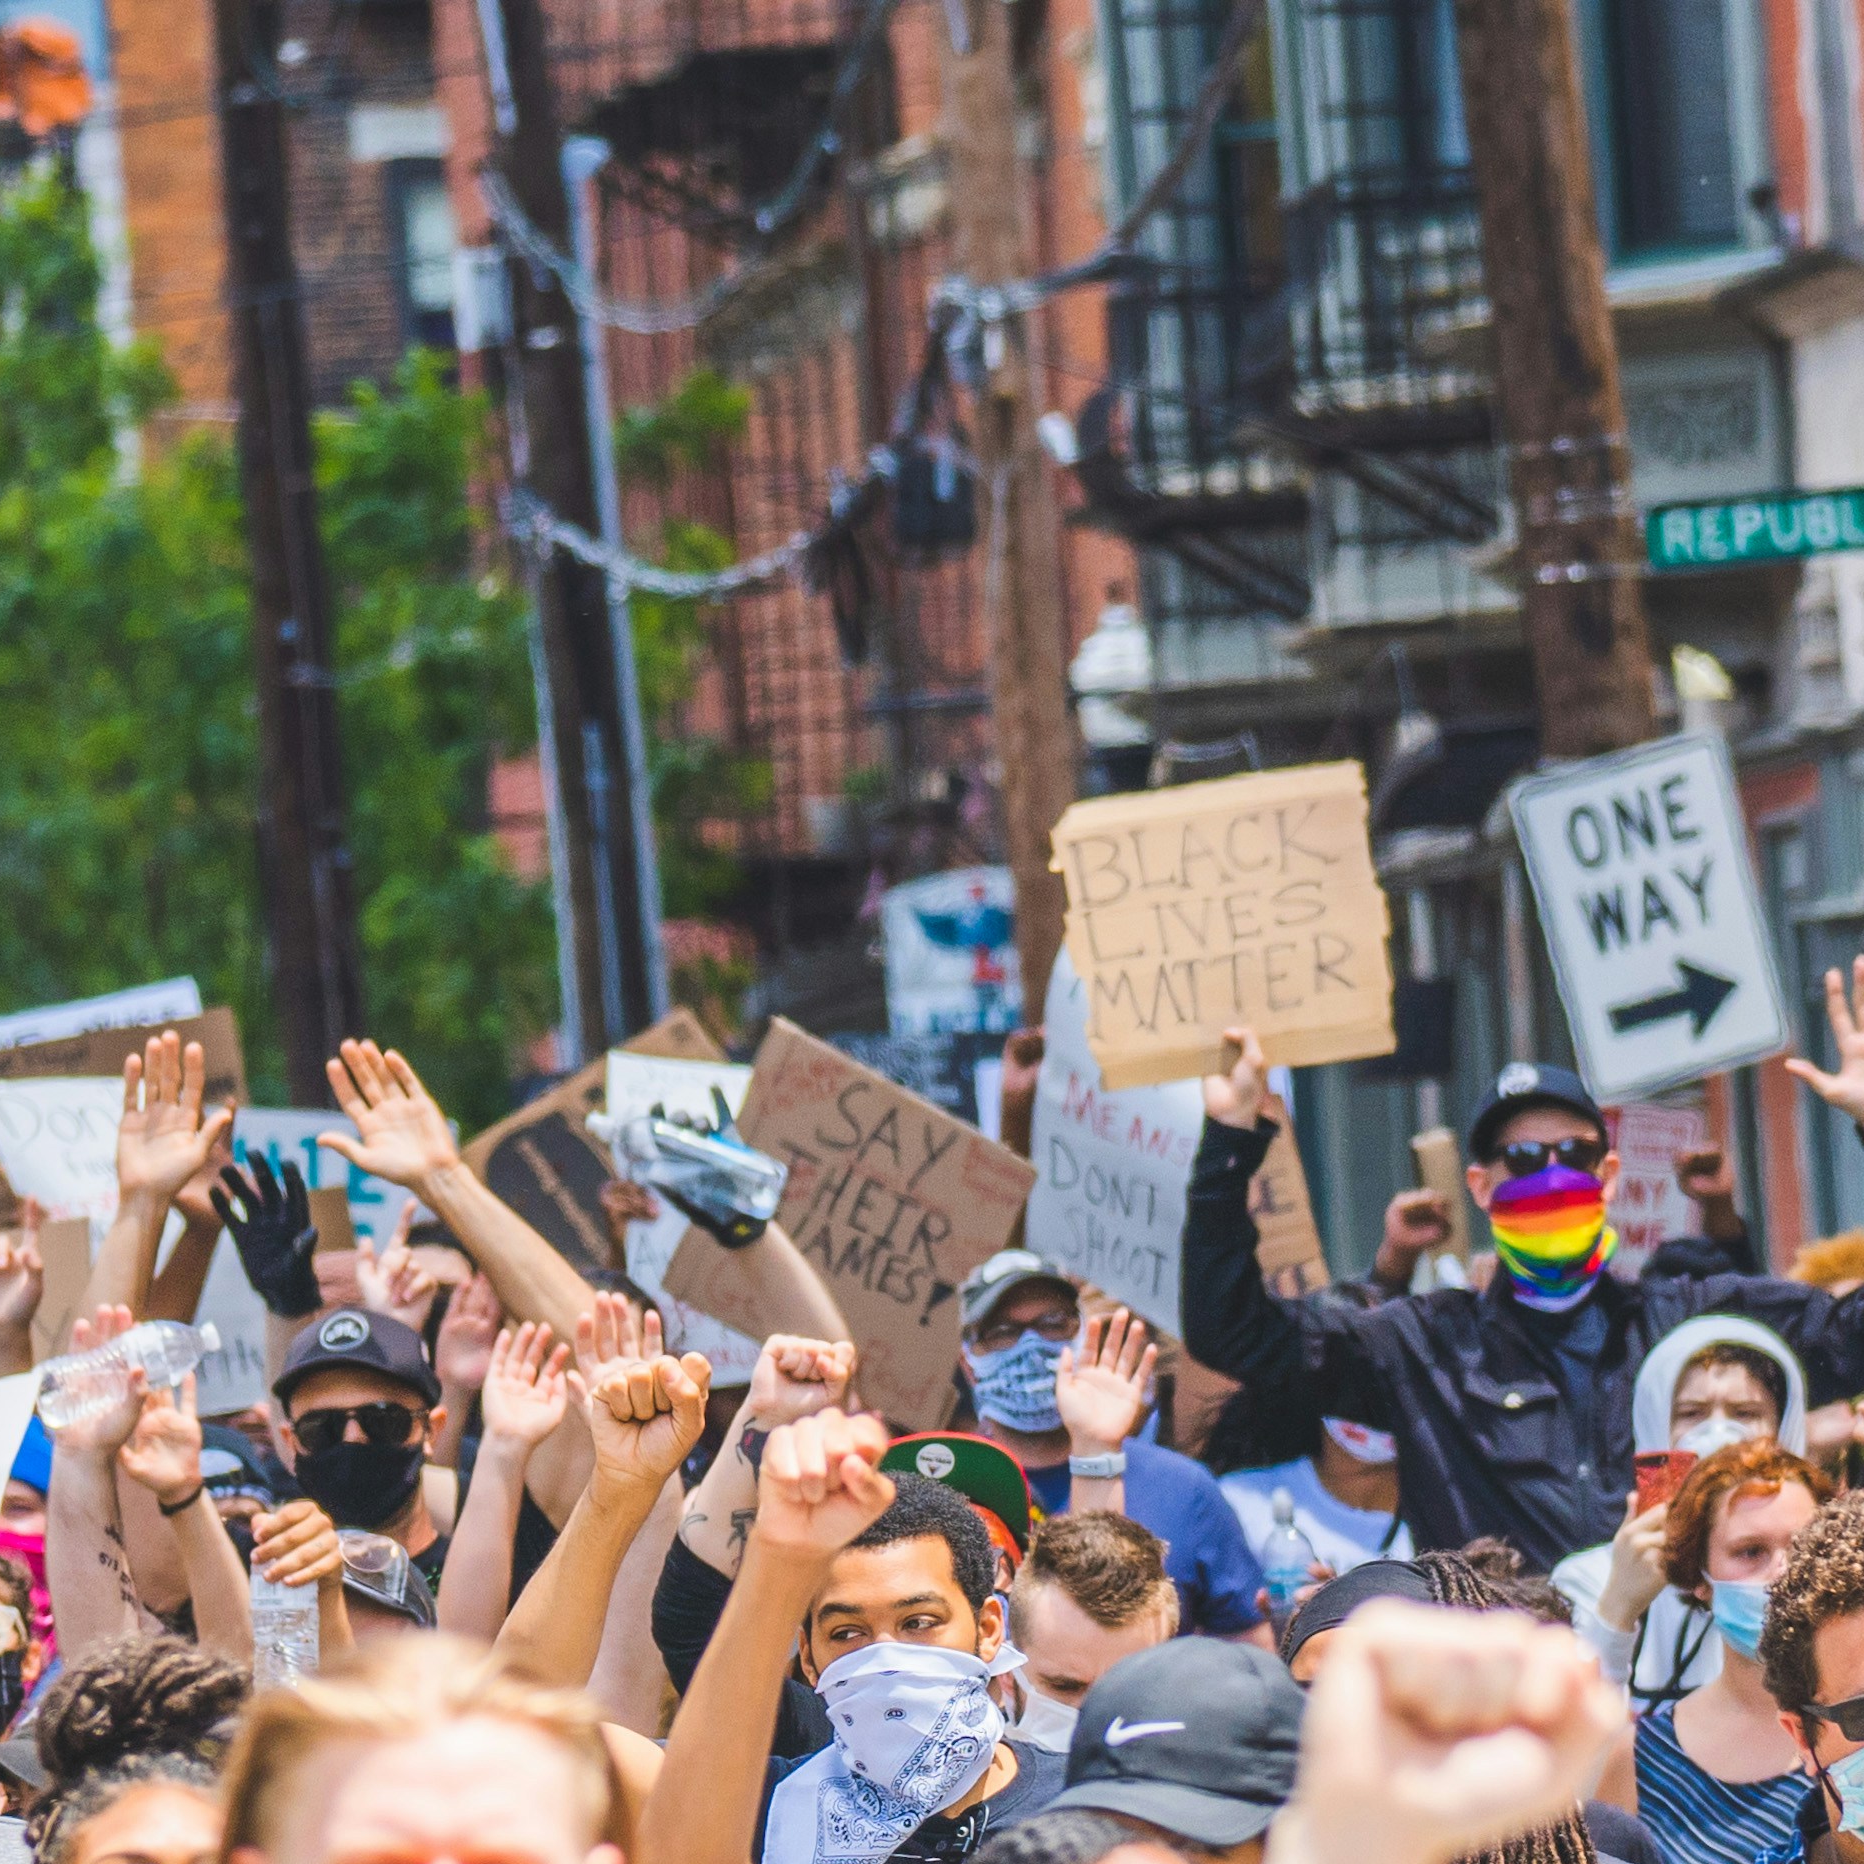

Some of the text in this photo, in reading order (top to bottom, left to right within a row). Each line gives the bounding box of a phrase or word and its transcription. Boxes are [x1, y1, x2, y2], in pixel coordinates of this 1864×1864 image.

[1067, 804, 1339, 907] BLACK
[1565, 774, 1700, 868] ONE
[1082, 880, 1328, 970] LIVES
[1575, 856, 1718, 954] WAY
[1091, 933, 1357, 1040] MATTER
[814, 1080, 958, 1188] SAY
[1061, 1071, 1195, 1166] MEANS
[781, 1140, 952, 1271] THEIR
[1048, 1135, 1159, 1227] DONT
